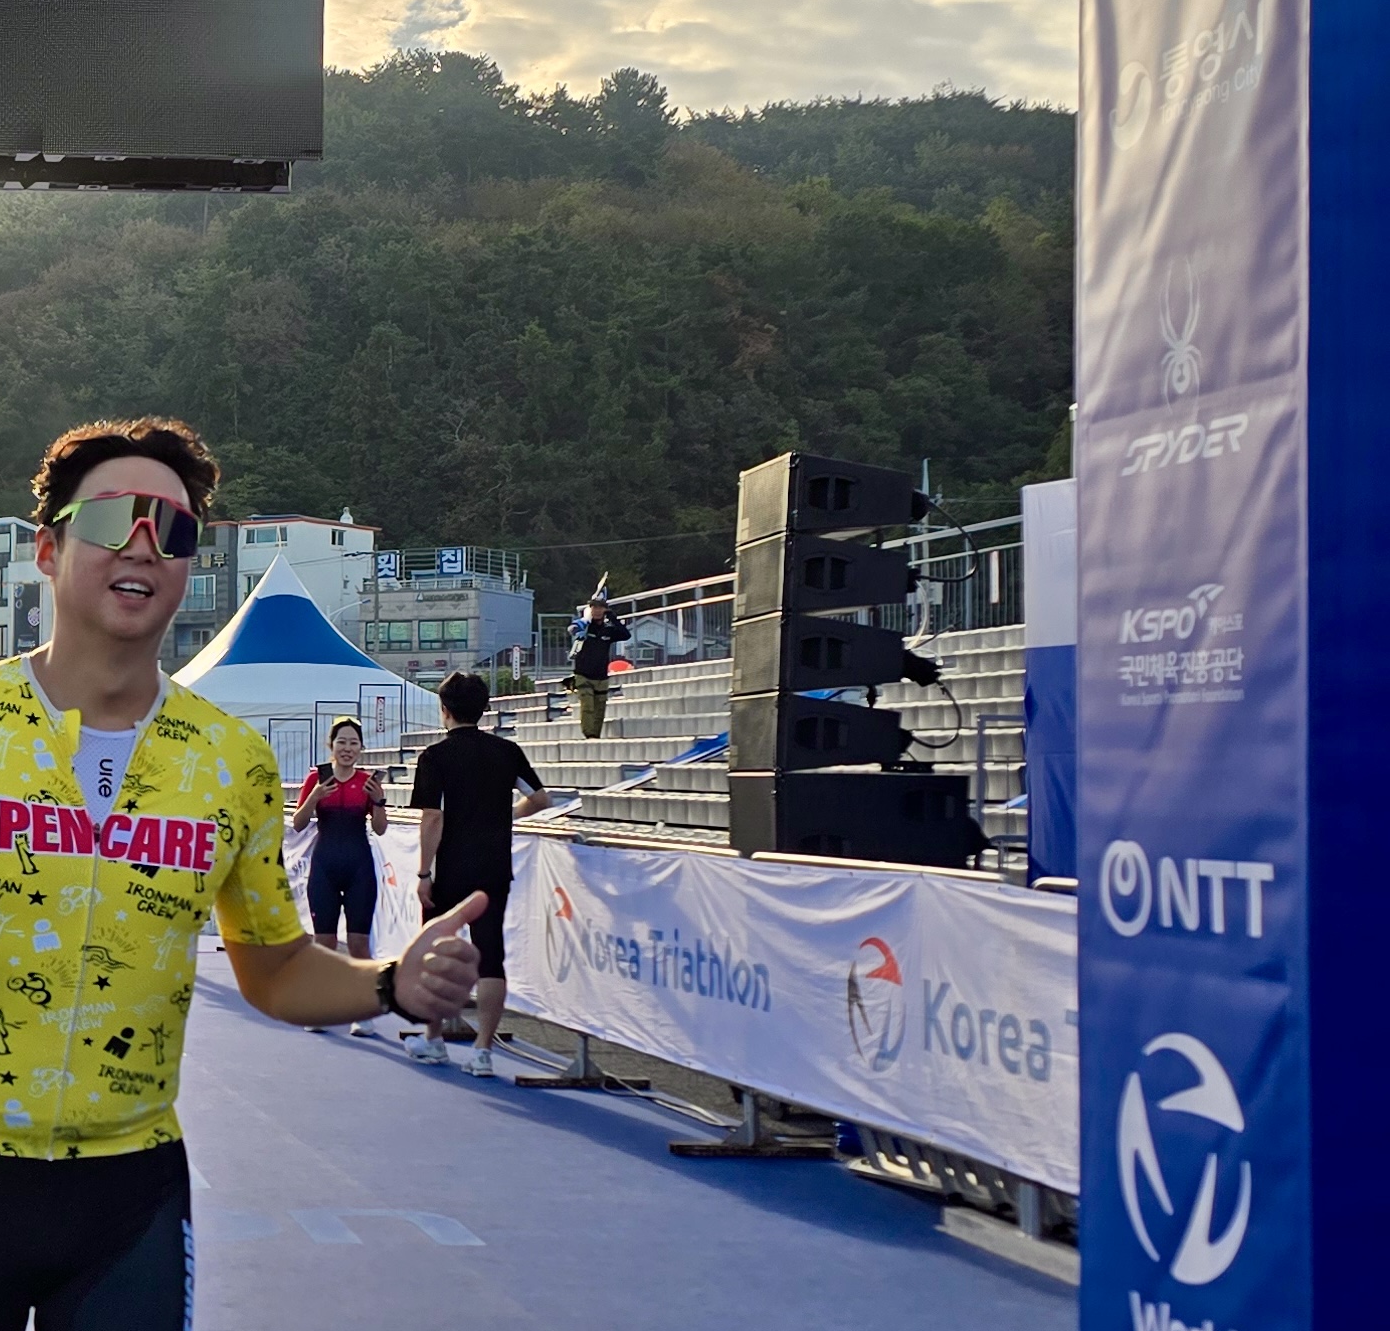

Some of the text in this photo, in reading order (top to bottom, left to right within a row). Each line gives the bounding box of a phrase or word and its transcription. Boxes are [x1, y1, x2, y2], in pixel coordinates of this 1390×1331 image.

[1234, 64, 1263, 92] City
[1121, 412, 1249, 477] SPYDER
[1118, 606, 1196, 645] KSPO
[1119, 646, 1244, 687] 국민체육진흥공단
[157, 727, 189, 743] CREW
[125, 881, 193, 912] IRONMAN
[136, 899, 178, 920] CREW
[1159, 856, 1274, 938] NTT
[647, 928, 772, 1012] Triathlon
[922, 978, 1053, 1082] Korea
[98, 1064, 155, 1086] IRONMAN
[109, 1080, 144, 1096] CREW
